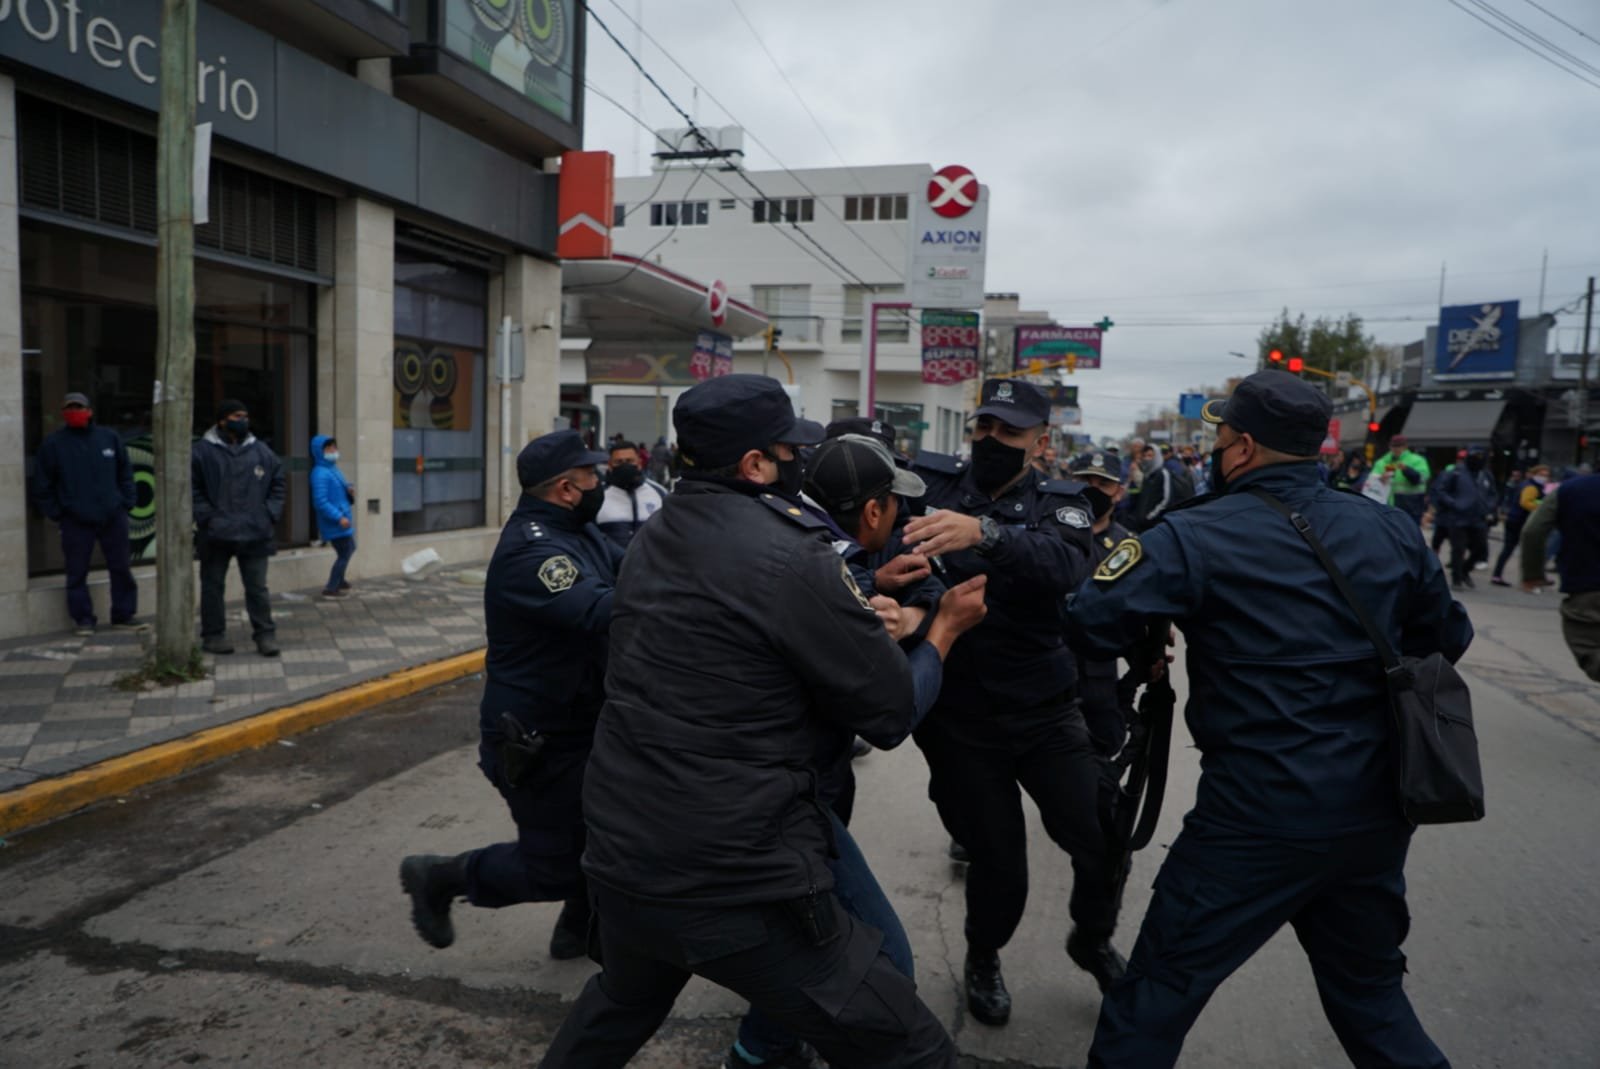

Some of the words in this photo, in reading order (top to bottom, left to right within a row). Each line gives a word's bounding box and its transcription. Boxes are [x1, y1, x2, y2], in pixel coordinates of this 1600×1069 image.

[0, 0, 258, 121] otecrio
[921, 230, 981, 244] AXION
[1020, 329, 1099, 340] FARMACIA
[923, 348, 977, 360] SUPER
